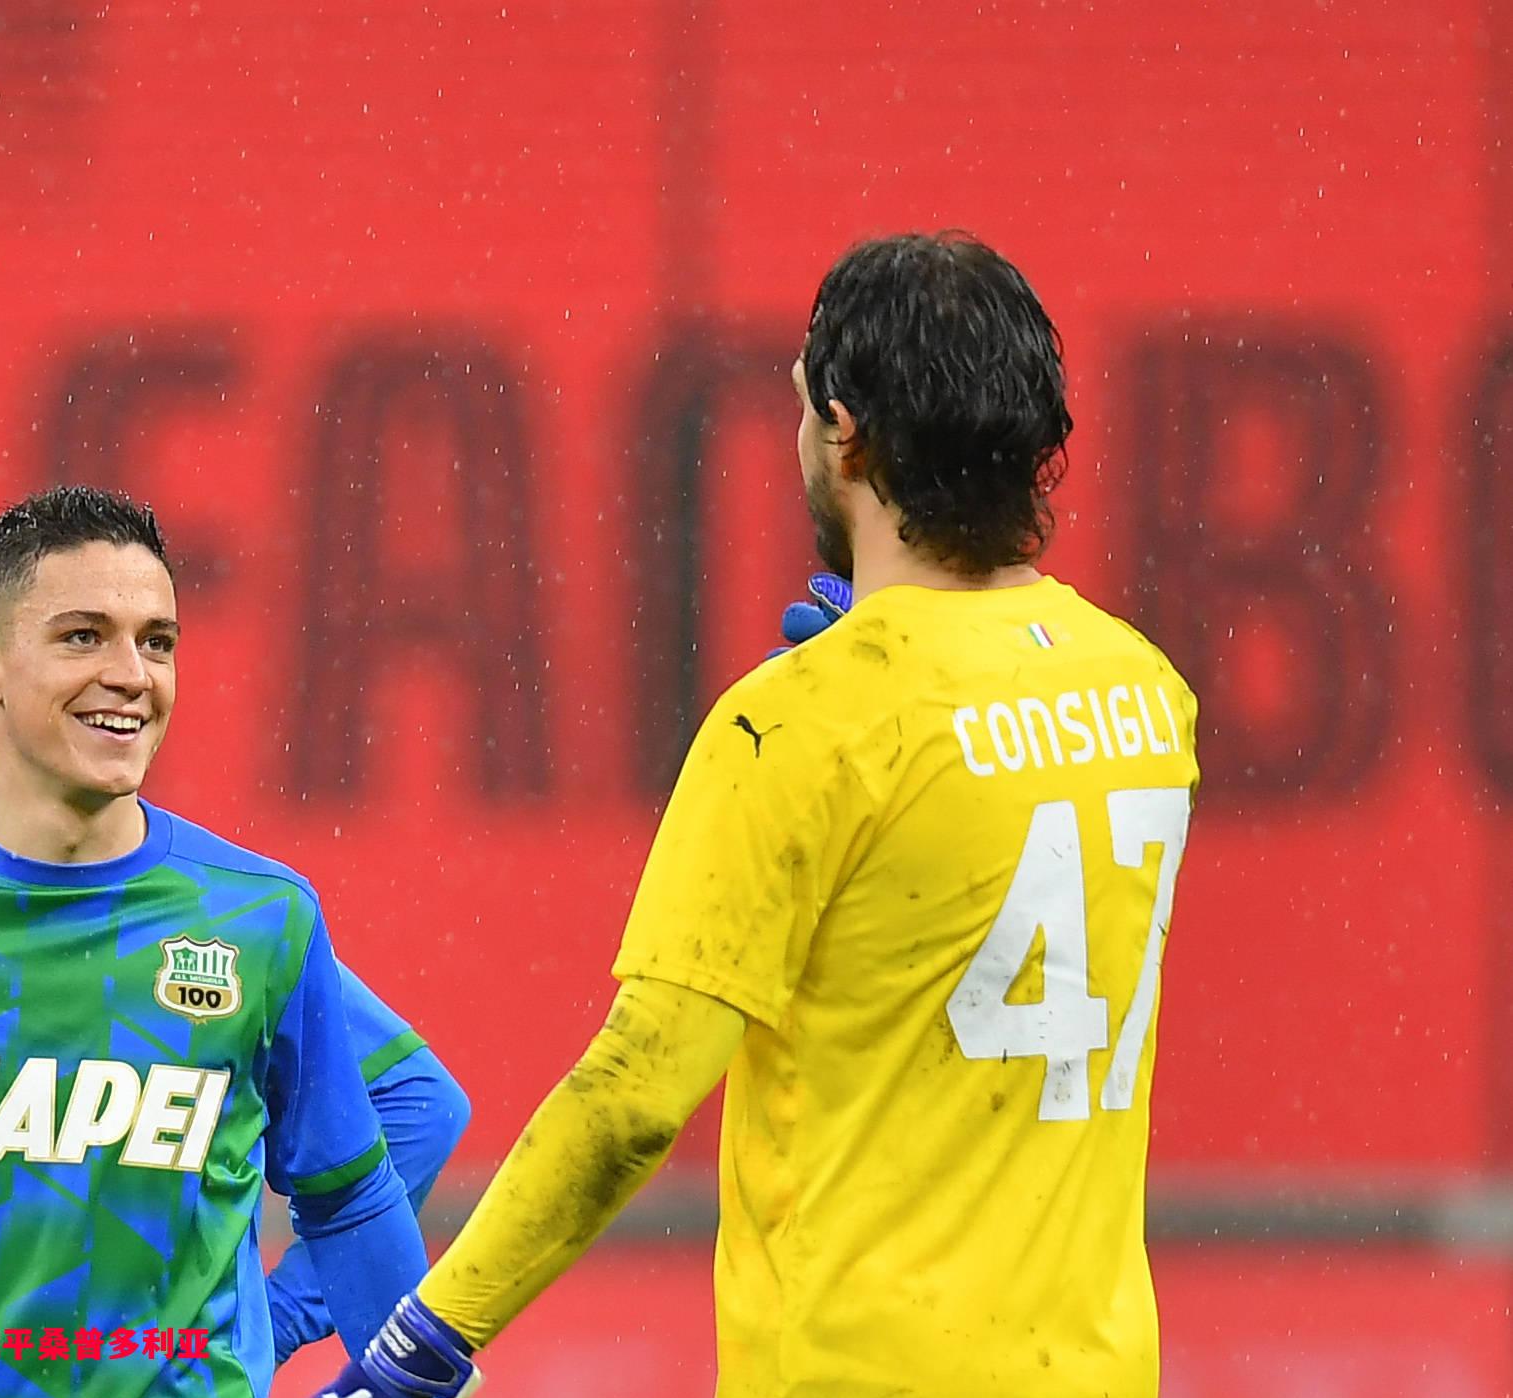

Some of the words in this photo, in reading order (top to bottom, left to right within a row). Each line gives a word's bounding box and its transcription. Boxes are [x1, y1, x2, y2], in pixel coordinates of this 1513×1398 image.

[953, 684, 1181, 777] CONSIGLI
[177, 986, 222, 1009] 100
[945, 787, 1190, 1121] 47
